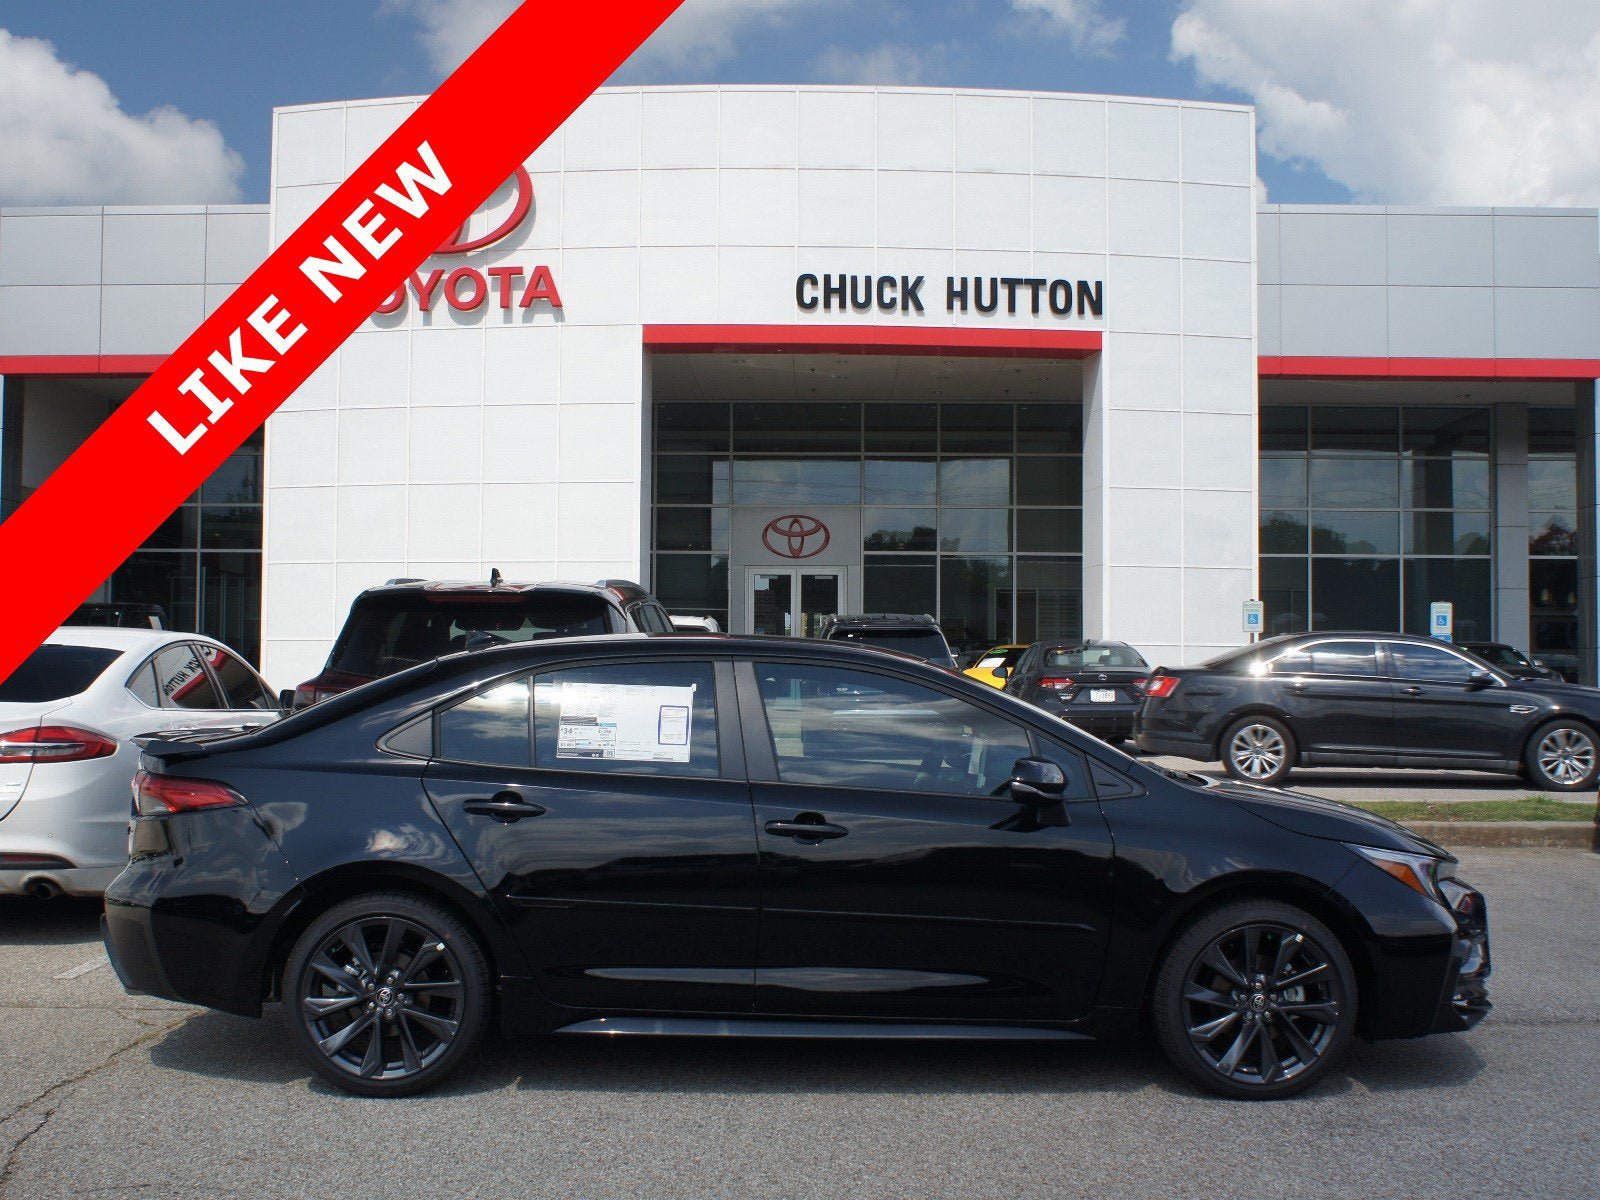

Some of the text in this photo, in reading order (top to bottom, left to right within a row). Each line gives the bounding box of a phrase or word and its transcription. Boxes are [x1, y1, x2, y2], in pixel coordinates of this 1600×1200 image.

[374, 265, 564, 314] YOTA
[796, 273, 1103, 316] CHUCK HUTTON
